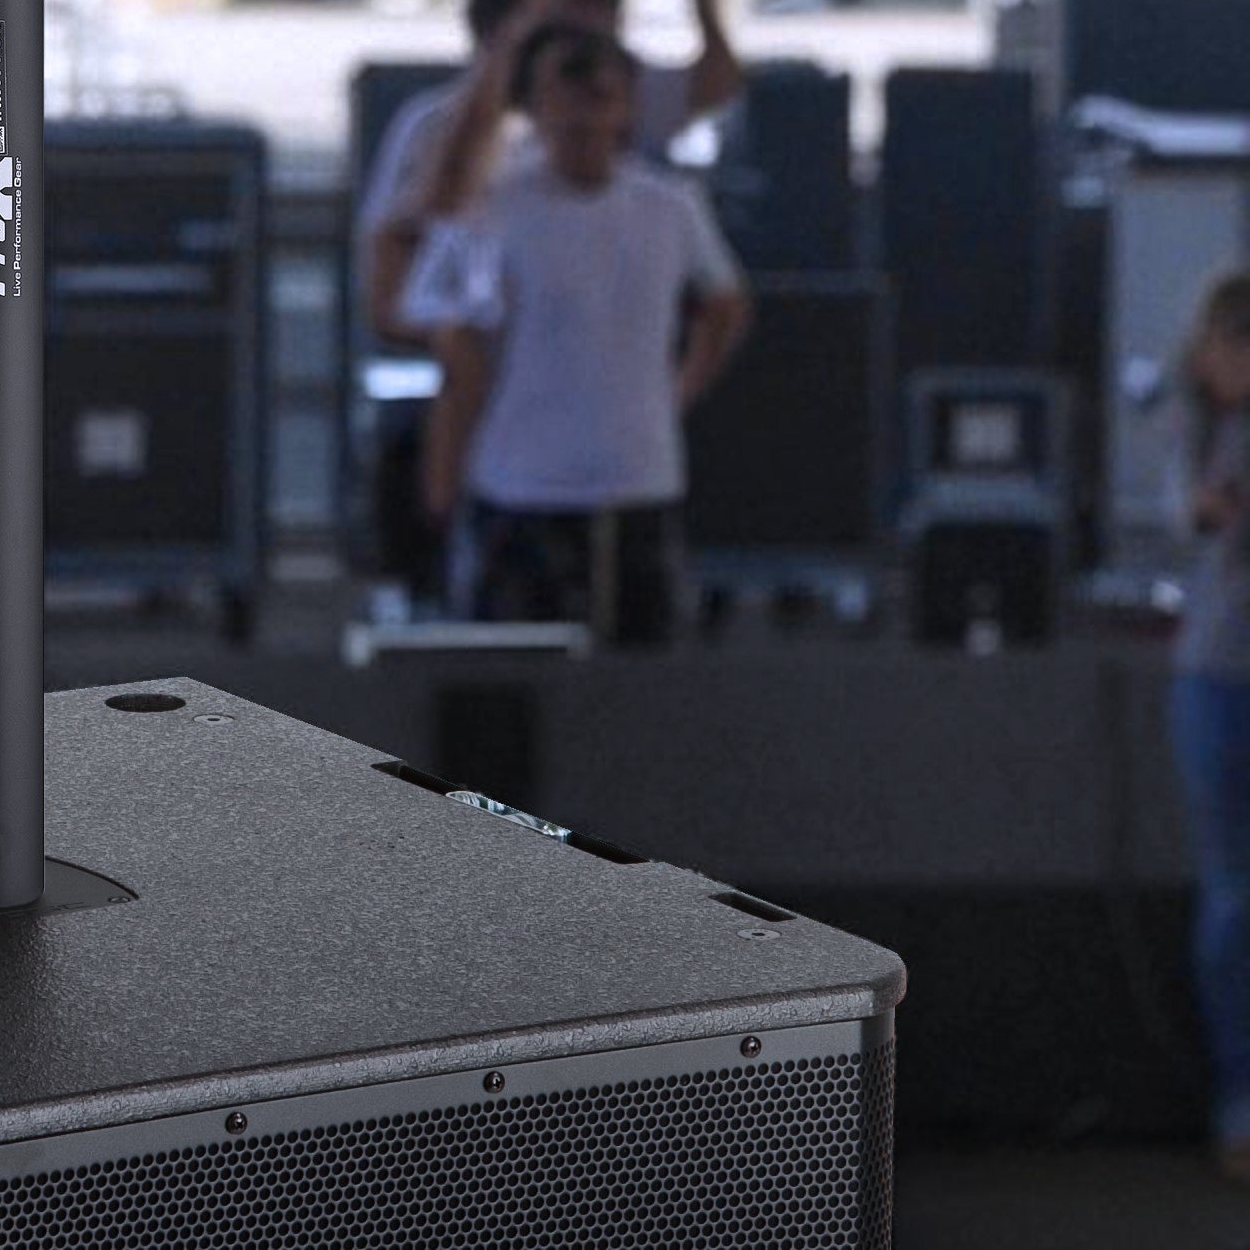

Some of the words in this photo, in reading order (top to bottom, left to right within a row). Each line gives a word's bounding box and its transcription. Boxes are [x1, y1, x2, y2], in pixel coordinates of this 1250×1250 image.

[14, 157, 22, 188] Gear
[13, 190, 22, 270] Performance
[13, 272, 21, 297] Live
